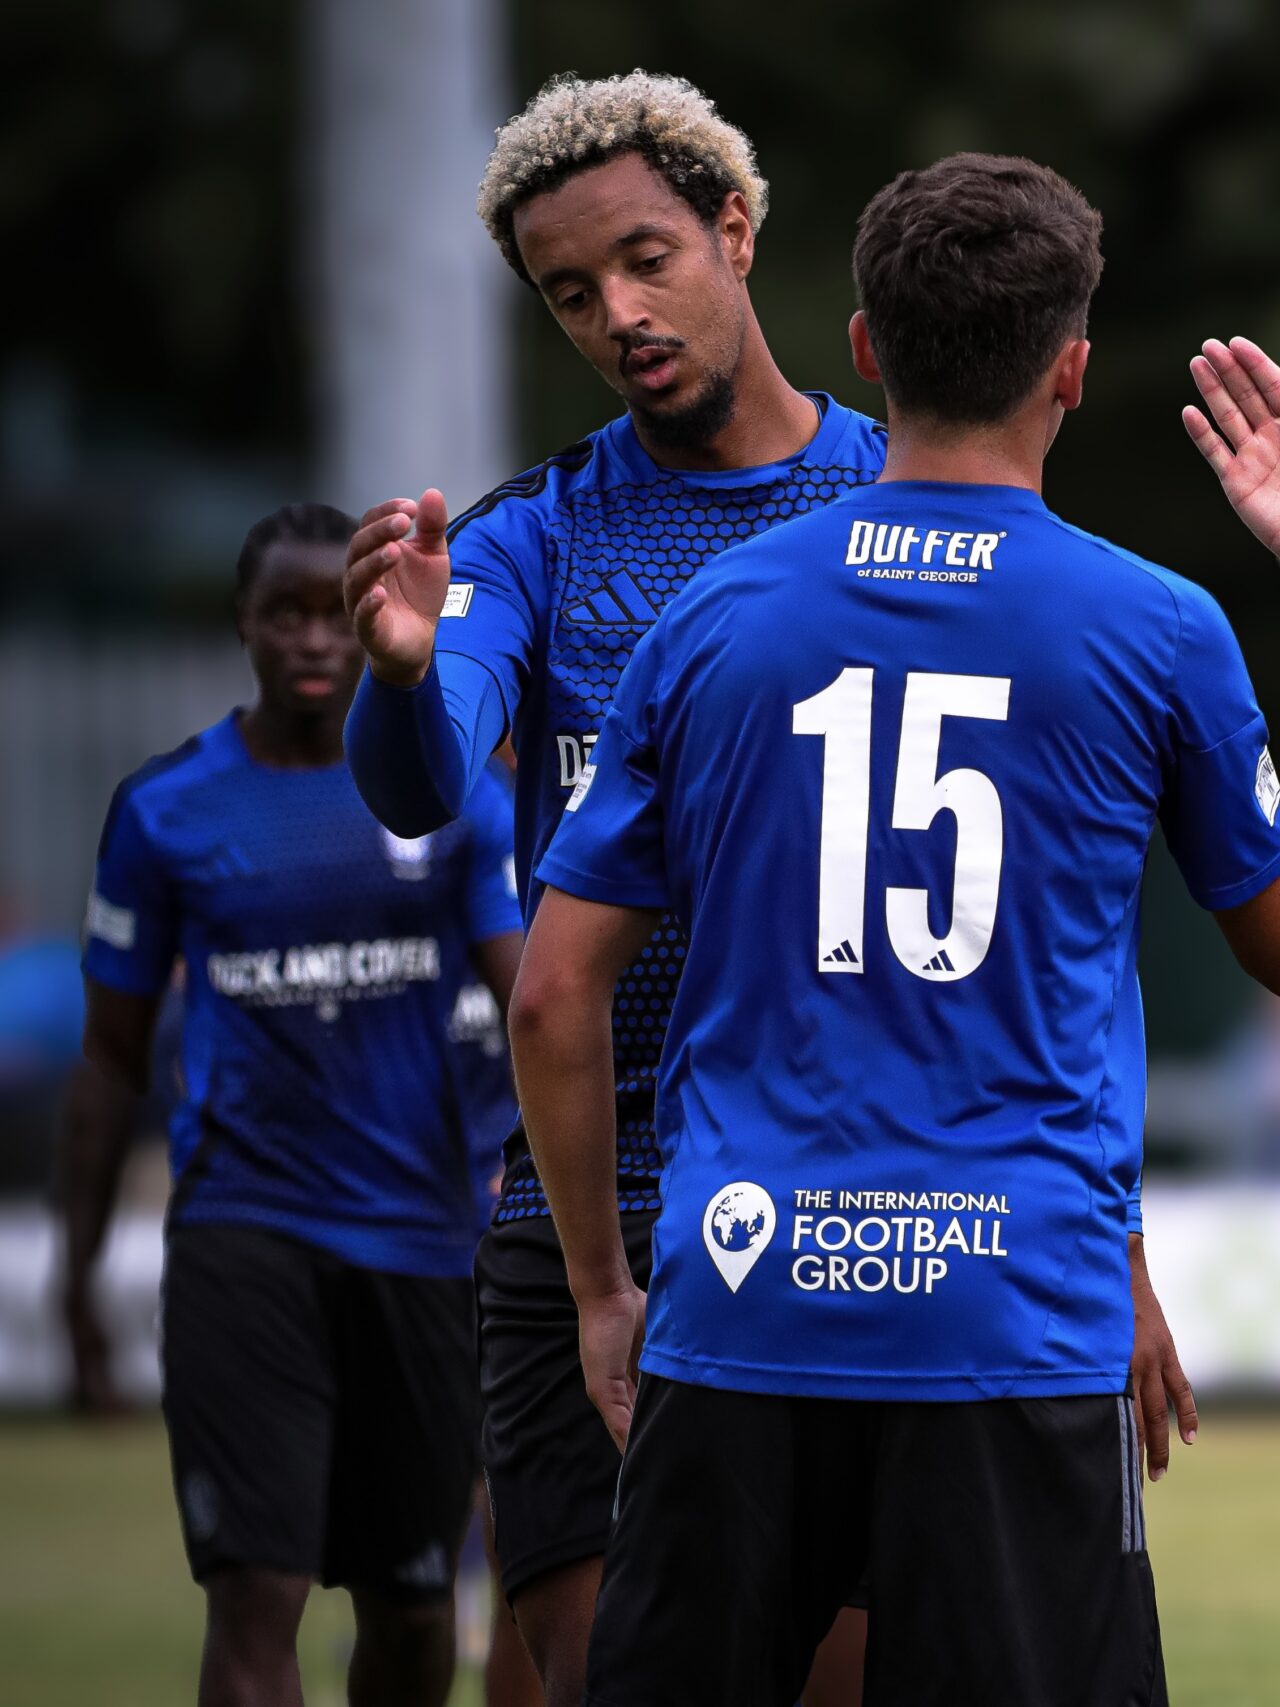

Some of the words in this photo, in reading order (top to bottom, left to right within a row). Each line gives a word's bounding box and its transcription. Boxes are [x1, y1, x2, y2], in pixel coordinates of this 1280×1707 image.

[845, 520, 999, 570] DUFFER
[857, 568, 870, 578] of
[872, 569, 915, 581] SAINT
[918, 571, 979, 583] GEORGE
[792, 667, 1012, 983] 15
[794, 1189, 832, 1208] THE
[839, 1190, 1011, 1214] INTERNATIONAL
[791, 1215, 1009, 1257] FOOTBALL
[791, 1254, 948, 1294] GROUP
